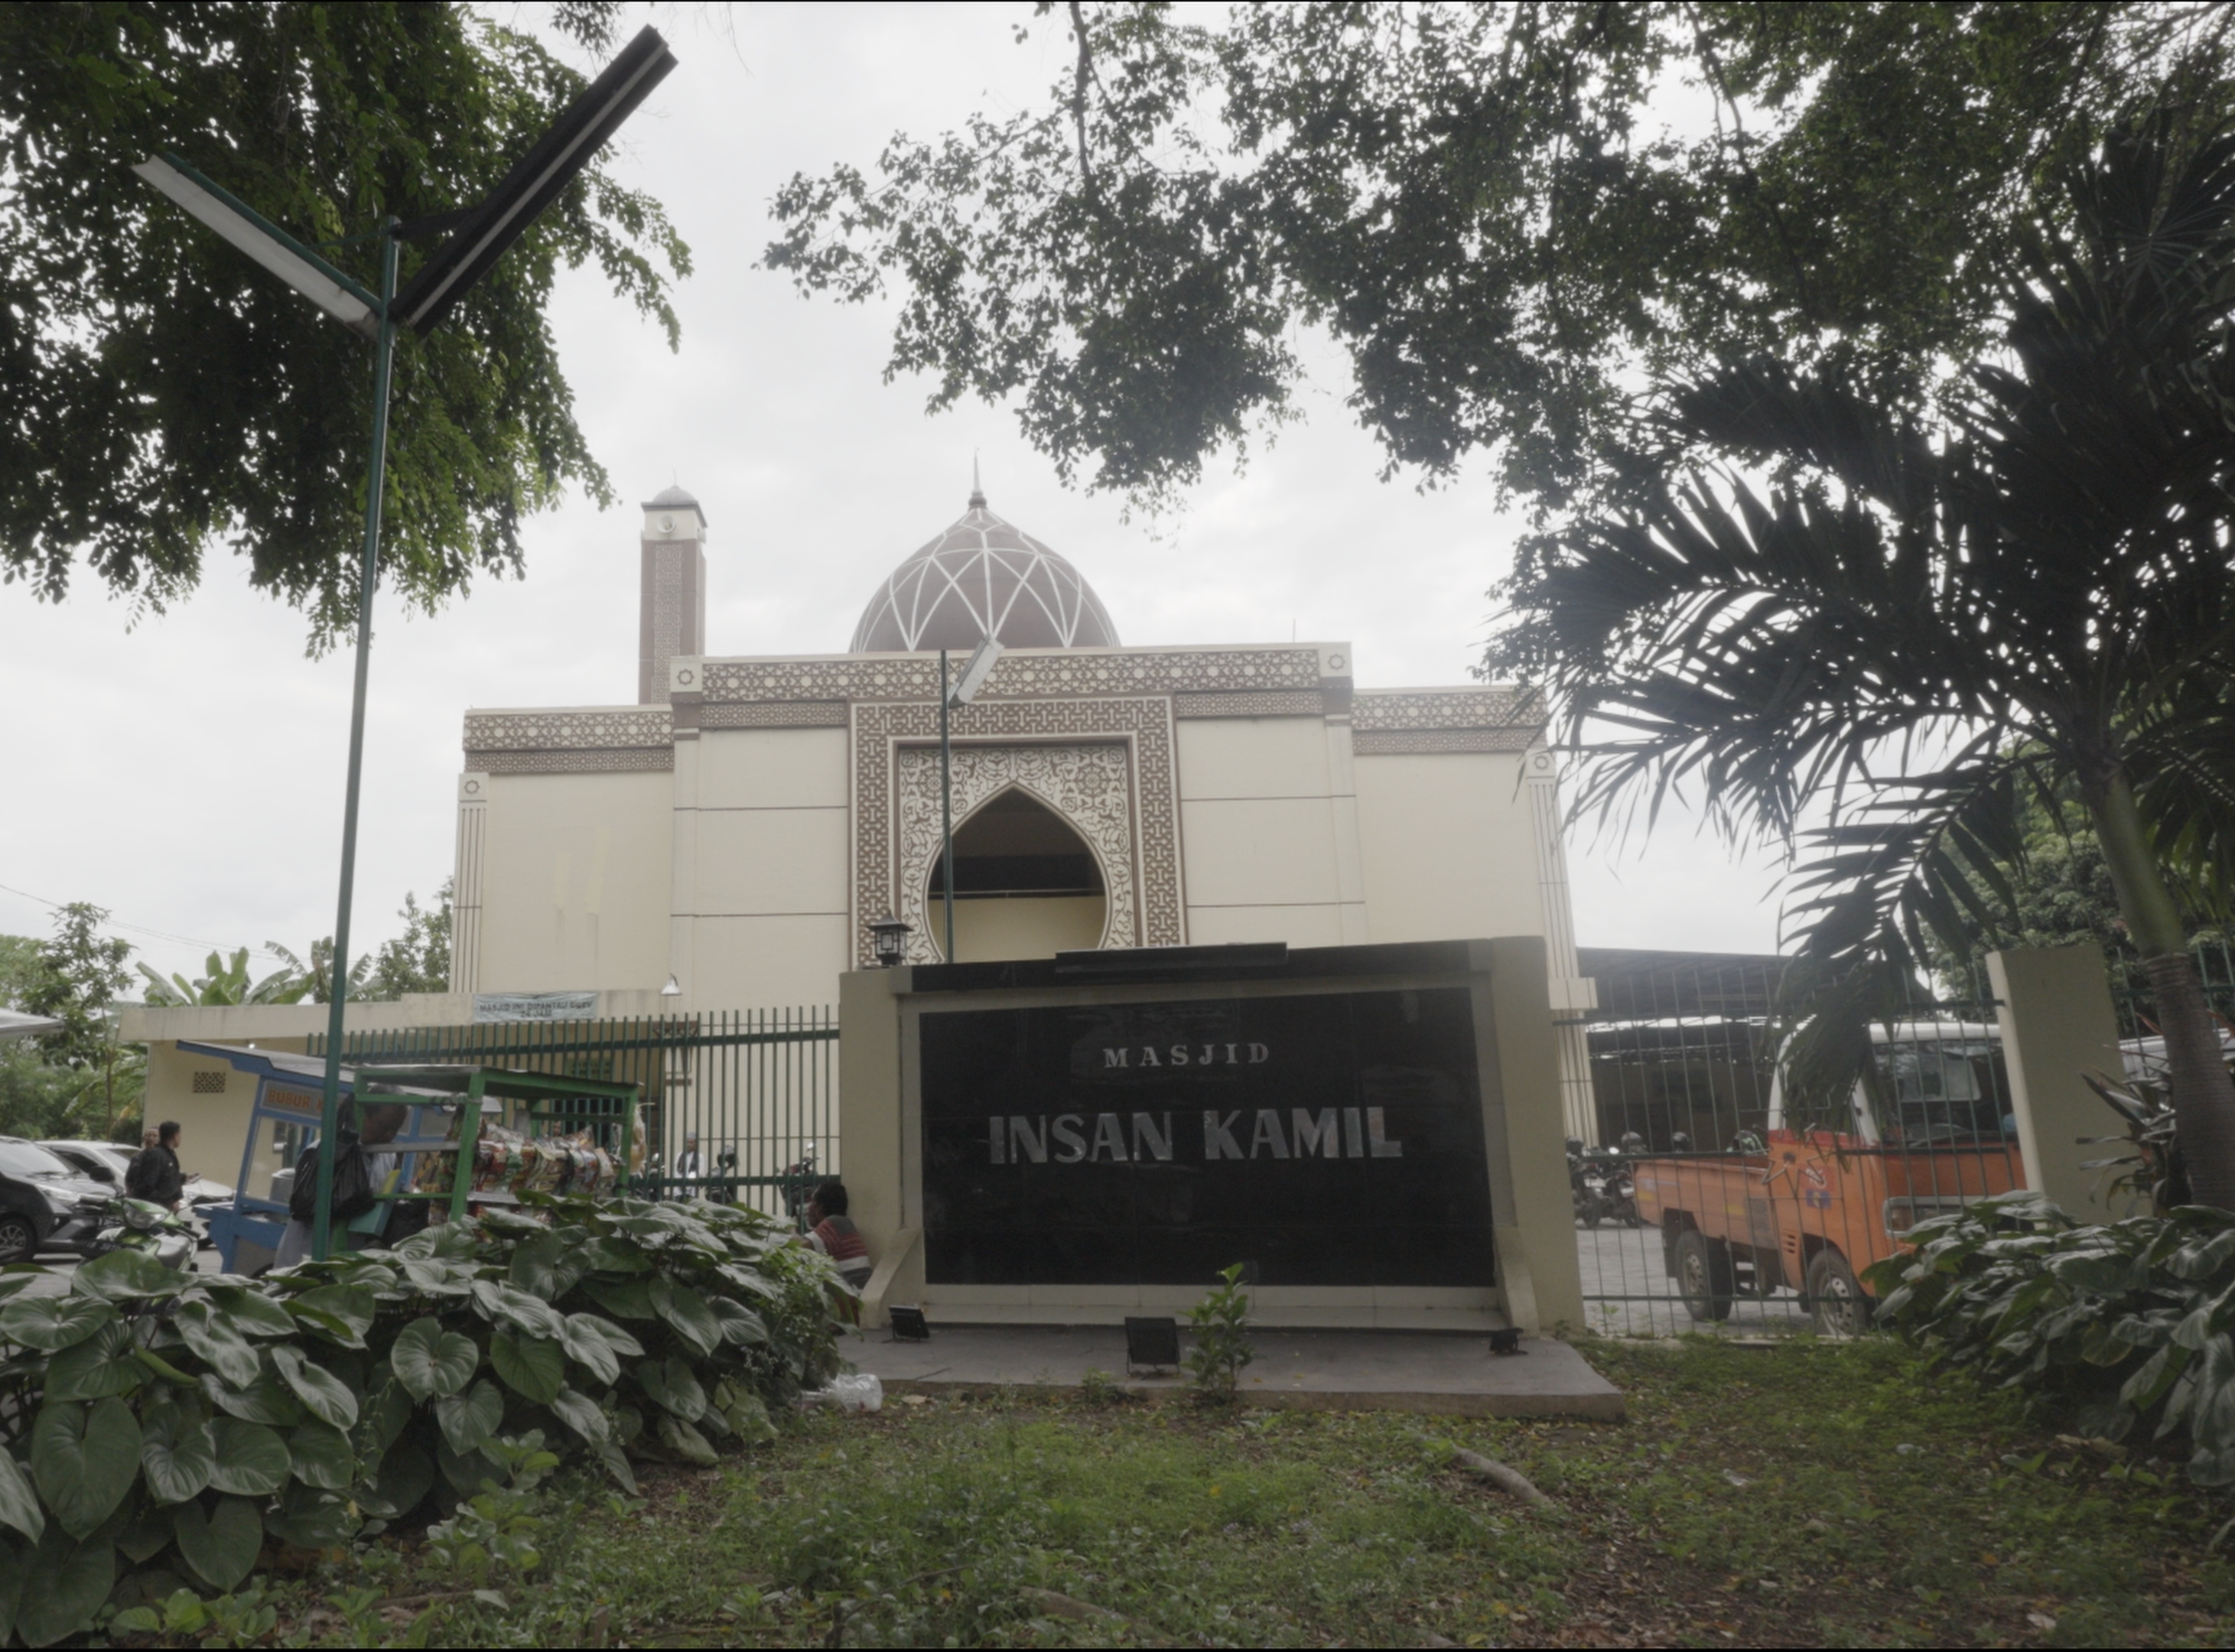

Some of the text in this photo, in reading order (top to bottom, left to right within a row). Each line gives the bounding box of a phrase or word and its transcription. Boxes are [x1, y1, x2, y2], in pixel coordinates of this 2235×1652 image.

[480, 1003, 510, 1012] MASJID
[512, 1003, 524, 1011] INI
[528, 1001, 568, 1010] DIPANTAU
[533, 1009, 553, 1017] JAM
[1104, 1042, 1270, 1068] MASJID
[266, 1089, 311, 1110] BUBUR
[989, 1106, 1404, 1165] INSAN KAMIL
